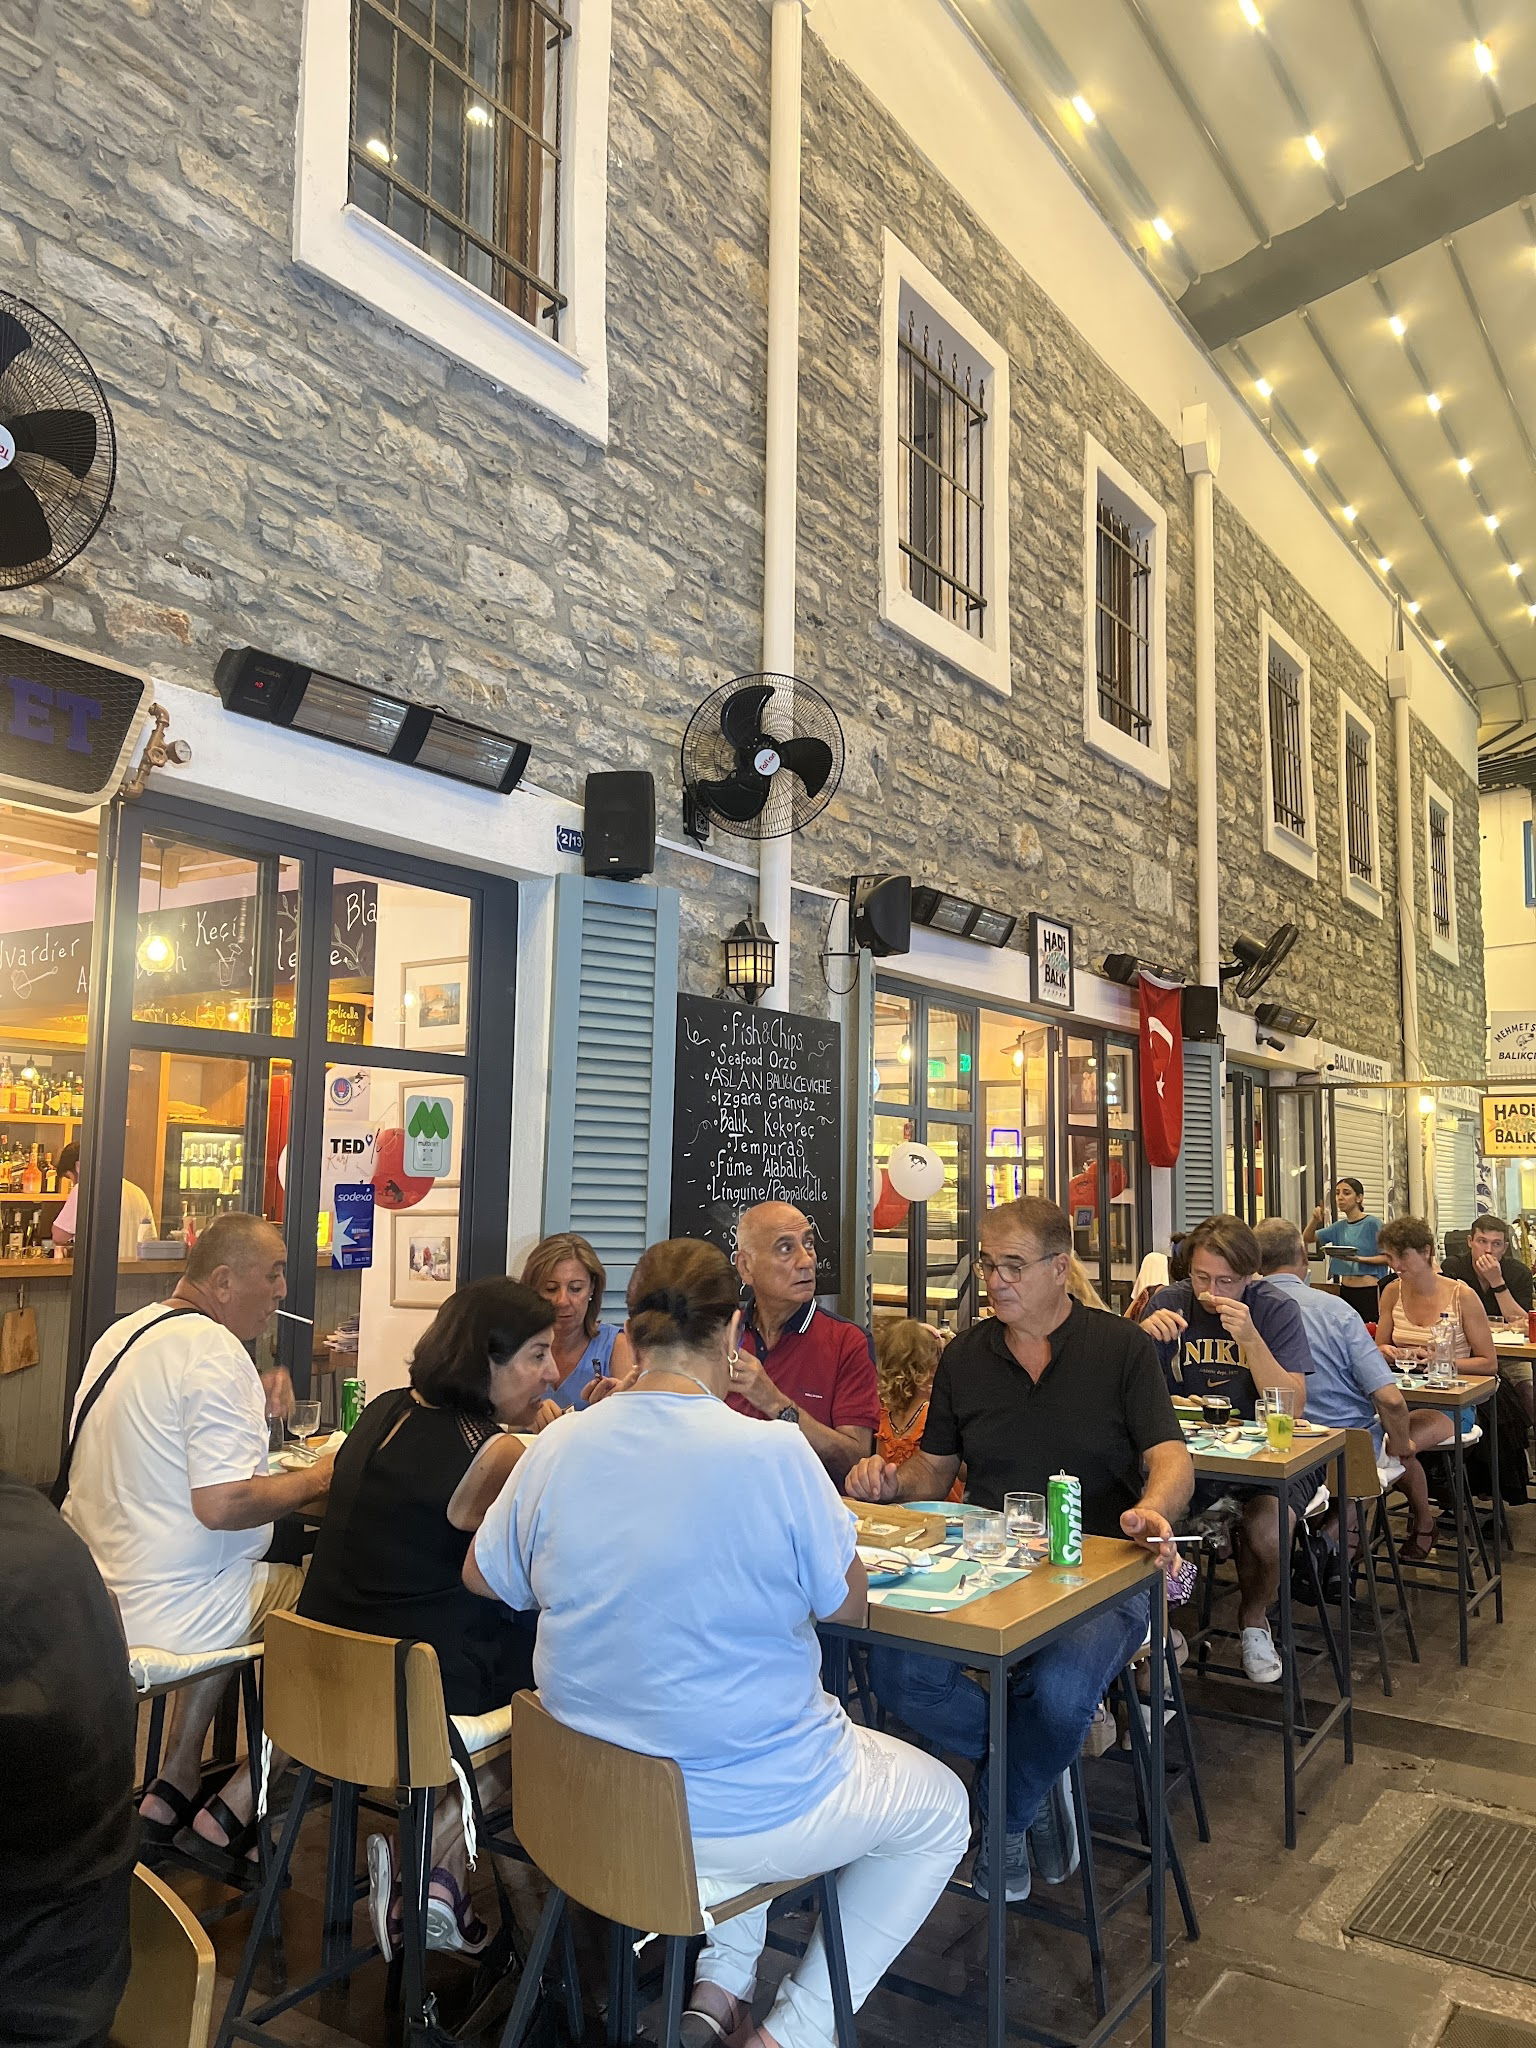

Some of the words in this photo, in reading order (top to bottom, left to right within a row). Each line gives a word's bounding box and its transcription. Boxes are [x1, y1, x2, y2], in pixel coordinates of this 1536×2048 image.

[561, 832, 582, 848] 2/13
[1494, 1022, 1530, 1043] MEHMET
[717, 1043, 763, 1070] Seafood
[769, 1051, 797, 1070] Orzo
[1334, 1053, 1355, 1074] BALIK
[1356, 1059, 1383, 1084] MARKET
[709, 1067, 763, 1091] ASLAN
[764, 1110, 815, 1140] Kokoreç
[330, 1138, 365, 1154] TED
[728, 1133, 804, 1162] Tempuras
[716, 1149, 753, 1178] Füme
[337, 1191, 372, 1202] sodexo
